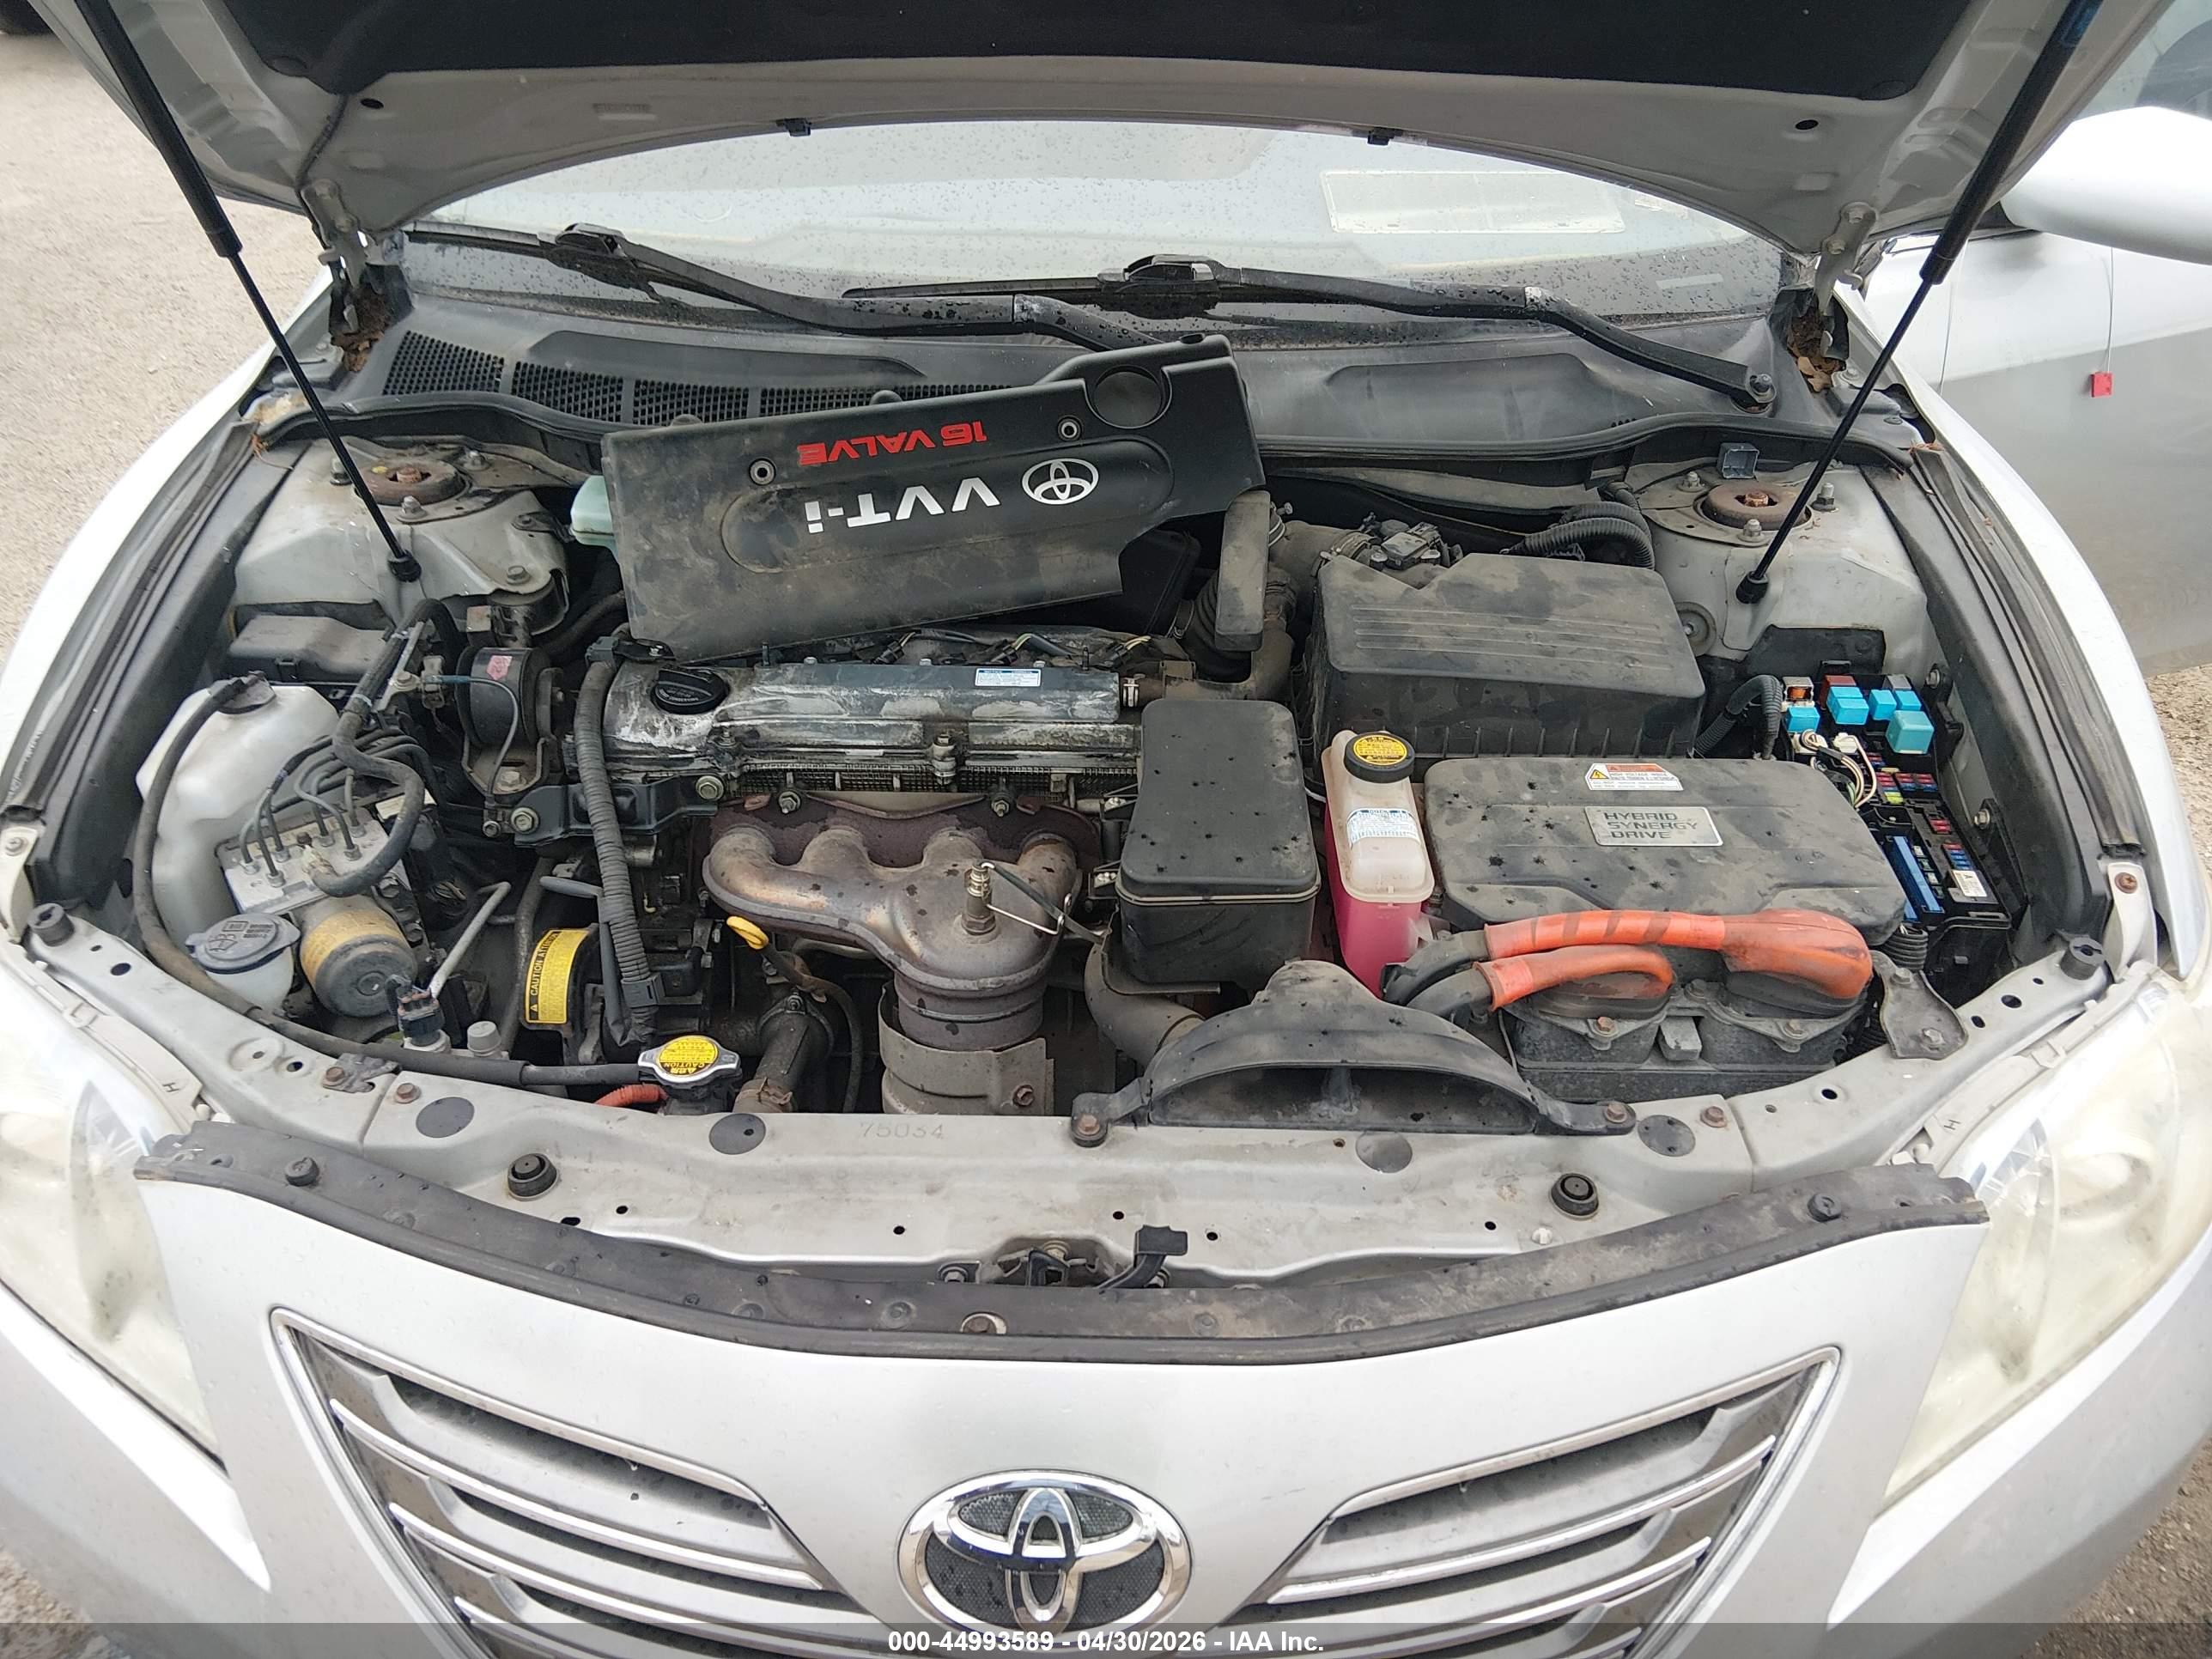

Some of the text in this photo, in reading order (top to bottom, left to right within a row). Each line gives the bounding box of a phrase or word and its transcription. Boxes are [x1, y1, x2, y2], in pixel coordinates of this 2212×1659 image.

[797, 421, 988, 466] 16 VALVE
[805, 477, 1000, 534] VVT-i
[1603, 811, 1678, 821] HYBRID
[1607, 821, 1698, 830] SYNERGY
[1611, 830, 1671, 839] DRIVE
[530, 960, 544, 996] CAUTION
